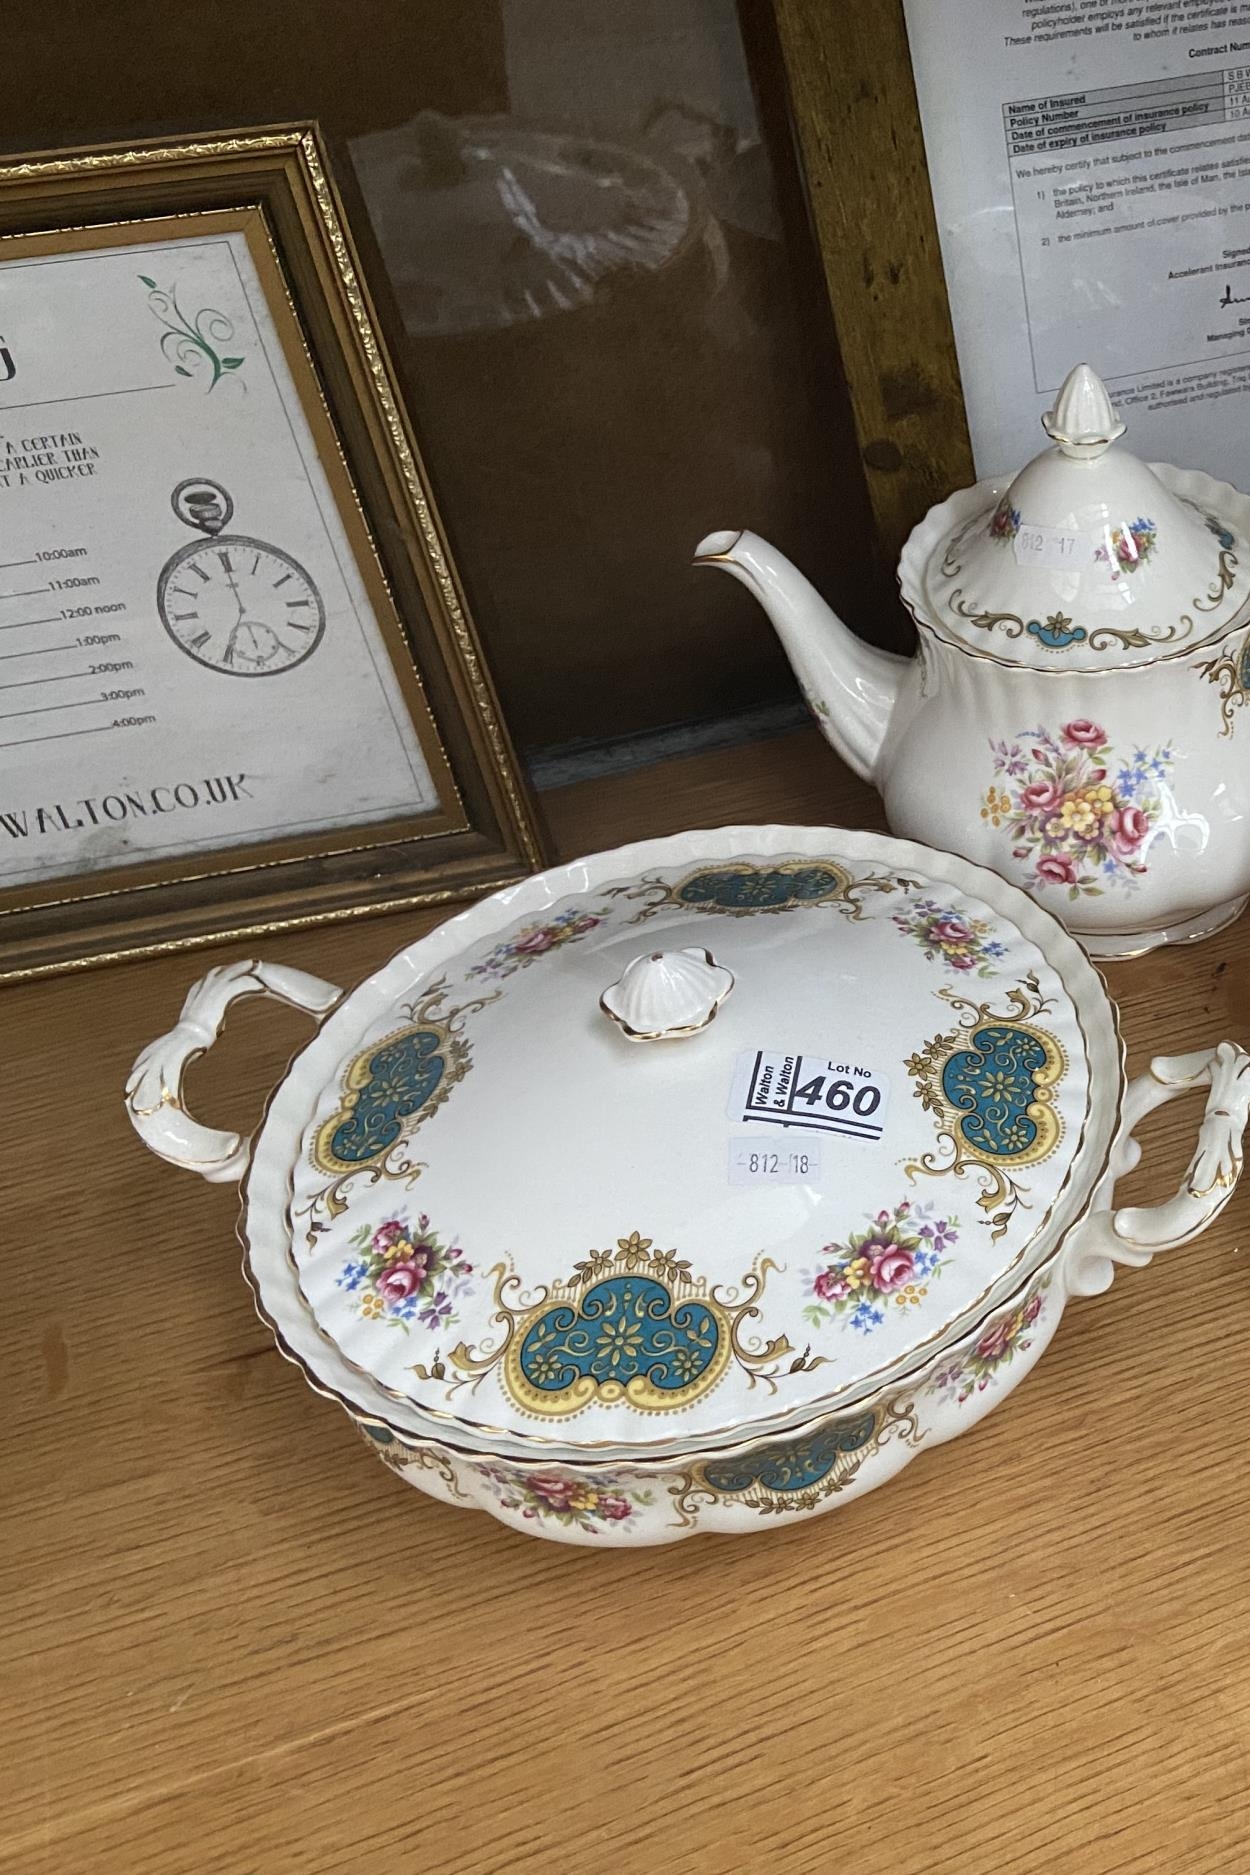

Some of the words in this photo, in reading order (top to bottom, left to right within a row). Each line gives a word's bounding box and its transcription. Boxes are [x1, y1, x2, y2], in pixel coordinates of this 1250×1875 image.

[1004, 34, 1032, 47] These
[1033, 26, 1093, 42] requirements
[1111, 22, 1122, 31] be
[1171, 13, 1185, 23] the
[1187, 7, 1228, 20] certificate
[1031, 14, 1085, 31] policyholder
[1127, 7, 1144, 17] any
[1133, 32, 1142, 41] to
[1179, 22, 1208, 34] relates
[1210, 20, 1226, 29] has
[1188, 44, 1228, 59] Contract
[1008, 102, 1036, 115] Name
[1038, 100, 1048, 110] of
[1050, 94, 1086, 109] Insured
[1228, 72, 1235, 81] S
[1010, 116, 1039, 127] Policy
[1042, 109, 1079, 123] Number
[1012, 130, 1034, 141] Date
[1036, 127, 1046, 137] of
[1048, 116, 1121, 135] commencement
[1123, 114, 1133, 124] of
[1134, 107, 1180, 121] insurance
[1182, 102, 1209, 115] policy
[1013, 143, 1035, 154] Date
[1037, 140, 1047, 149] of
[1049, 136, 1078, 149] expiry
[1080, 134, 1090, 143] of
[1091, 127, 1137, 141] insurance
[1139, 122, 1167, 136] policy
[1015, 168, 1031, 179] We
[1033, 162, 1063, 175] hereby
[1065, 159, 1092, 171] certify
[1093, 156, 1110, 167] that
[1111, 152, 1142, 165] subject
[1144, 149, 1152, 158] to
[1154, 146, 1168, 156] the
[1169, 135, 1236, 154] commencement
[1053, 187, 1067, 197] the
[1069, 182, 1093, 196] policy
[1095, 181, 1104, 190] to
[1106, 177, 1131, 188] which
[1132, 173, 1147, 183] this
[1149, 167, 1190, 181] certificate
[1086, 189, 1124, 203] Northern
[1158, 181, 1172, 191] the
[1191, 176, 1199, 185] of
[1223, 170, 1236, 180] the
[1098, 201, 1115, 213] and
[1057, 233, 1072, 243] the
[1073, 227, 1112, 240] minimum
[1113, 220, 1145, 234] amount
[1147, 218, 1156, 228] of
[1156, 215, 1180, 226] cover
[1181, 206, 1217, 222] provided
[1218, 206, 1228, 217] by
[1230, 203, 1243, 213] the
[1222, 246, 1250, 259] Signed
[1168, 264, 1213, 280] Accelerant
[1206, 329, 1245, 342] Managing
[1137, 380, 1166, 393] Limited
[21, 431, 84, 452] CERTAIN
[62, 446, 100, 463] THAN
[35, 462, 98, 485] QUICKER
[35, 546, 88, 563] 10:00am
[49, 575, 101, 592] 11:00am
[60, 606, 93, 620] 12:00
[94, 602, 127, 615] noon
[76, 632, 122, 648] 1:00pm
[88, 660, 134, 676] 2:00pm
[101, 687, 146, 702] 3:00pm
[112, 714, 157, 731] 4:00pm
[775, 1056, 795, 1096] Walton
[827, 1061, 850, 1075] Lot
[853, 1066, 872, 1079] No
[755, 1065, 775, 1106] Walton
[773, 1099, 786, 1108] &
[794, 1075, 882, 1117] 460
[749, 1153, 780, 1174] 812
[792, 1154, 810, 1175] 18
